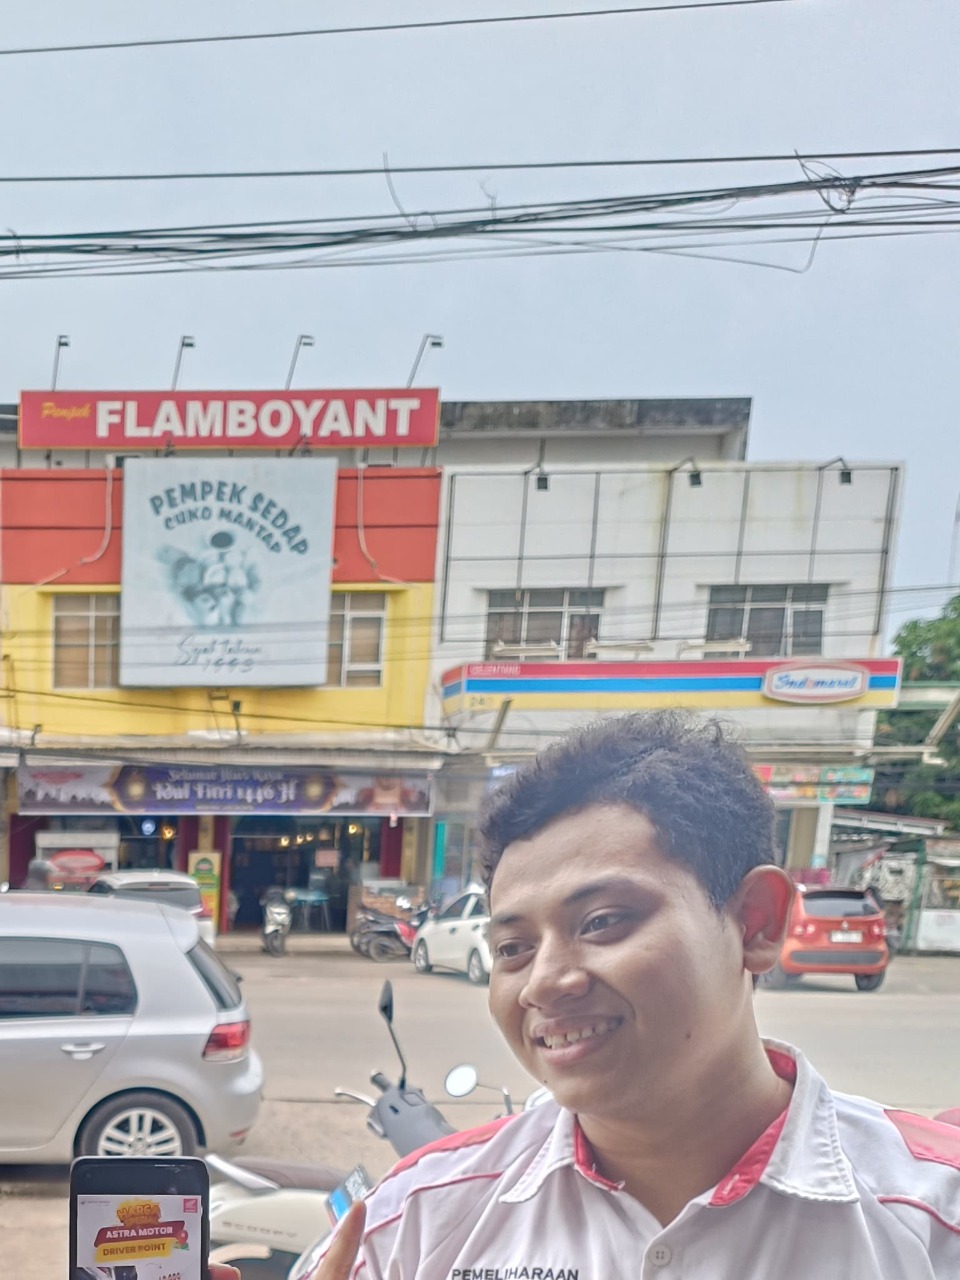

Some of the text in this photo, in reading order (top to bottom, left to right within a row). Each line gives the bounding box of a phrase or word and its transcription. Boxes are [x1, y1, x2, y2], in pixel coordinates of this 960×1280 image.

[96, 398, 420, 438] FLAMBOYANT
[149, 480, 309, 555] PEMPEK SEDAP
[164, 506, 282, 553] CUKO MANTAP
[103, 1243, 166, 1256] DRIVER POINT
[106, 1226, 173, 1239] ASTRA MOTOR
